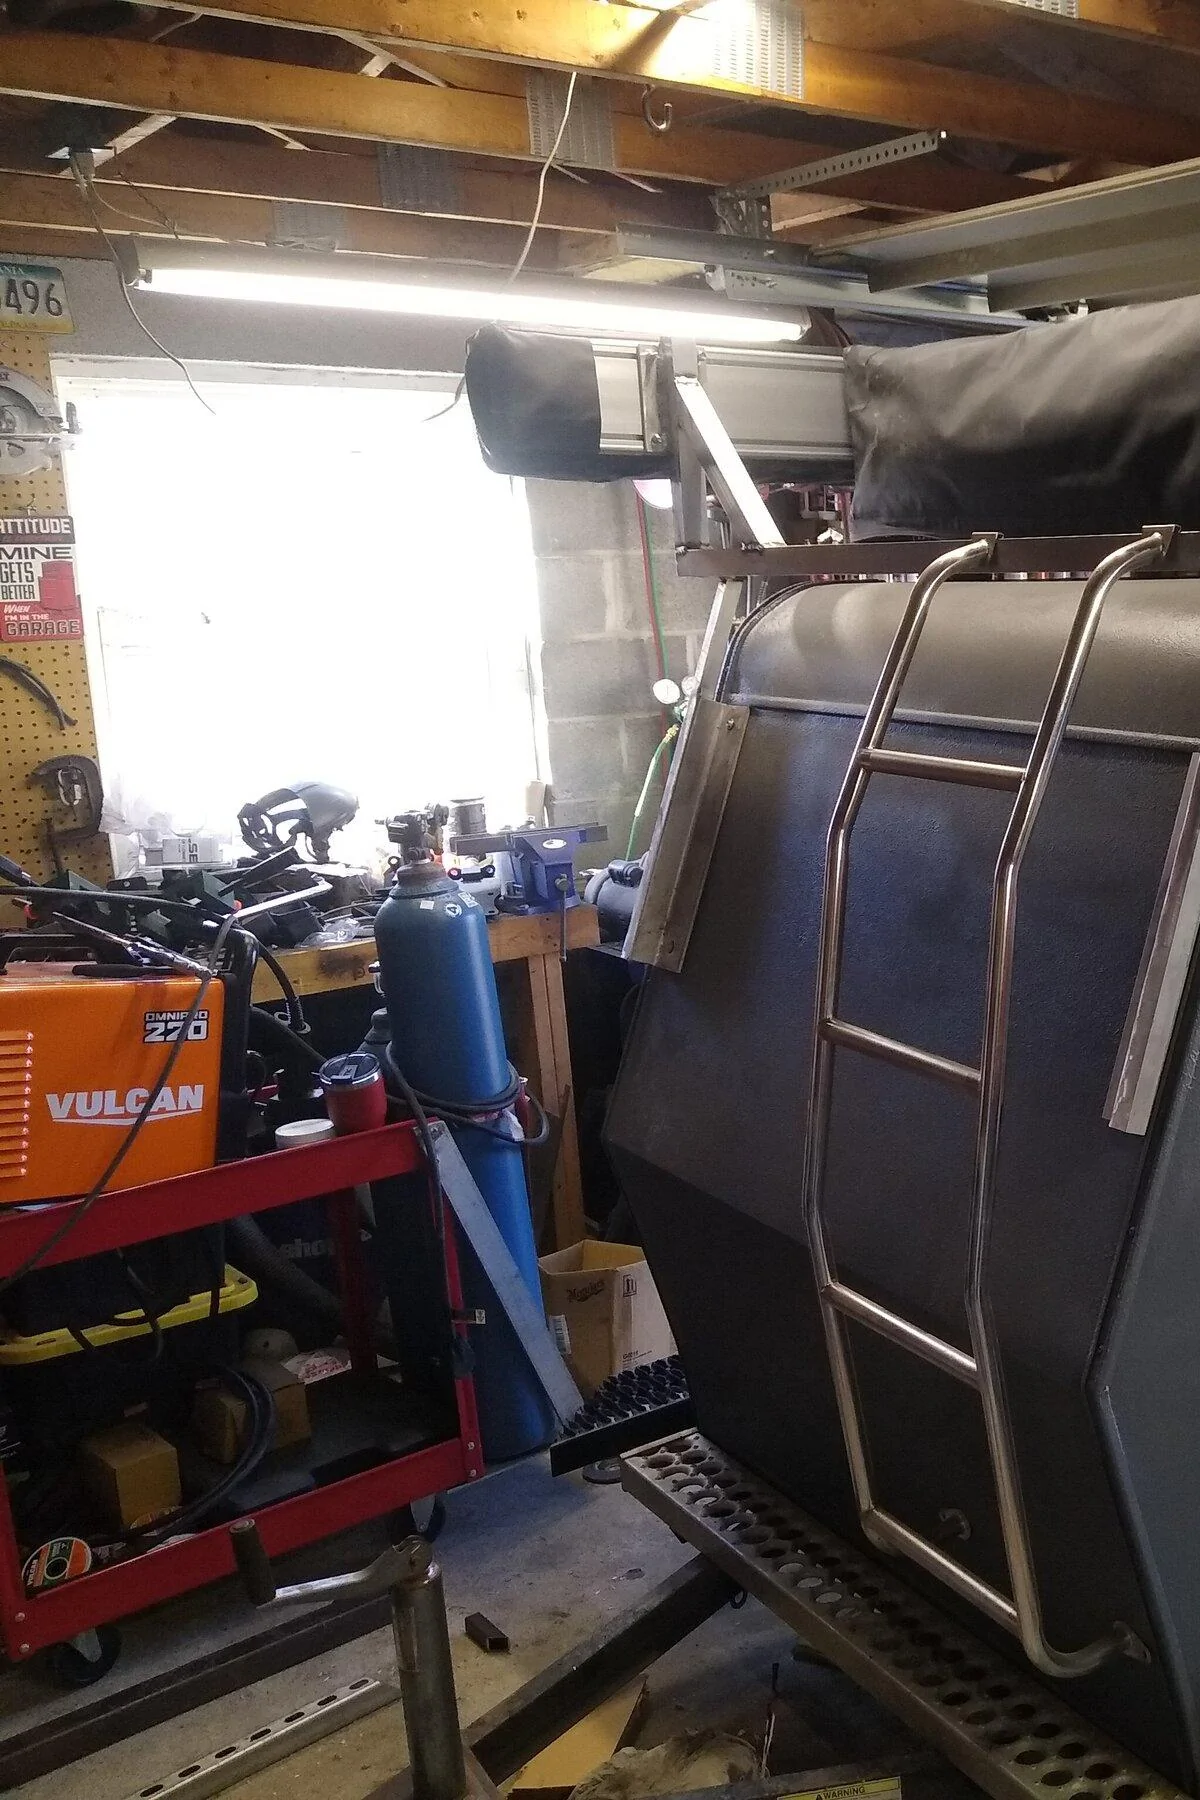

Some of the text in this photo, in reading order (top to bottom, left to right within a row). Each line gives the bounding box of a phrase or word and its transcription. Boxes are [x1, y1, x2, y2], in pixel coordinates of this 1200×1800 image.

[6, 279, 62, 316] 496
[0, 547, 73, 560] MINE
[0, 562, 34, 583] GETS
[1, 584, 35, 600] BETTER
[5, 619, 80, 636] GARAGE
[145, 1020, 208, 1042] 220
[46, 1084, 204, 1119] VULCAN
[822, 1785, 866, 1800] WARNING
